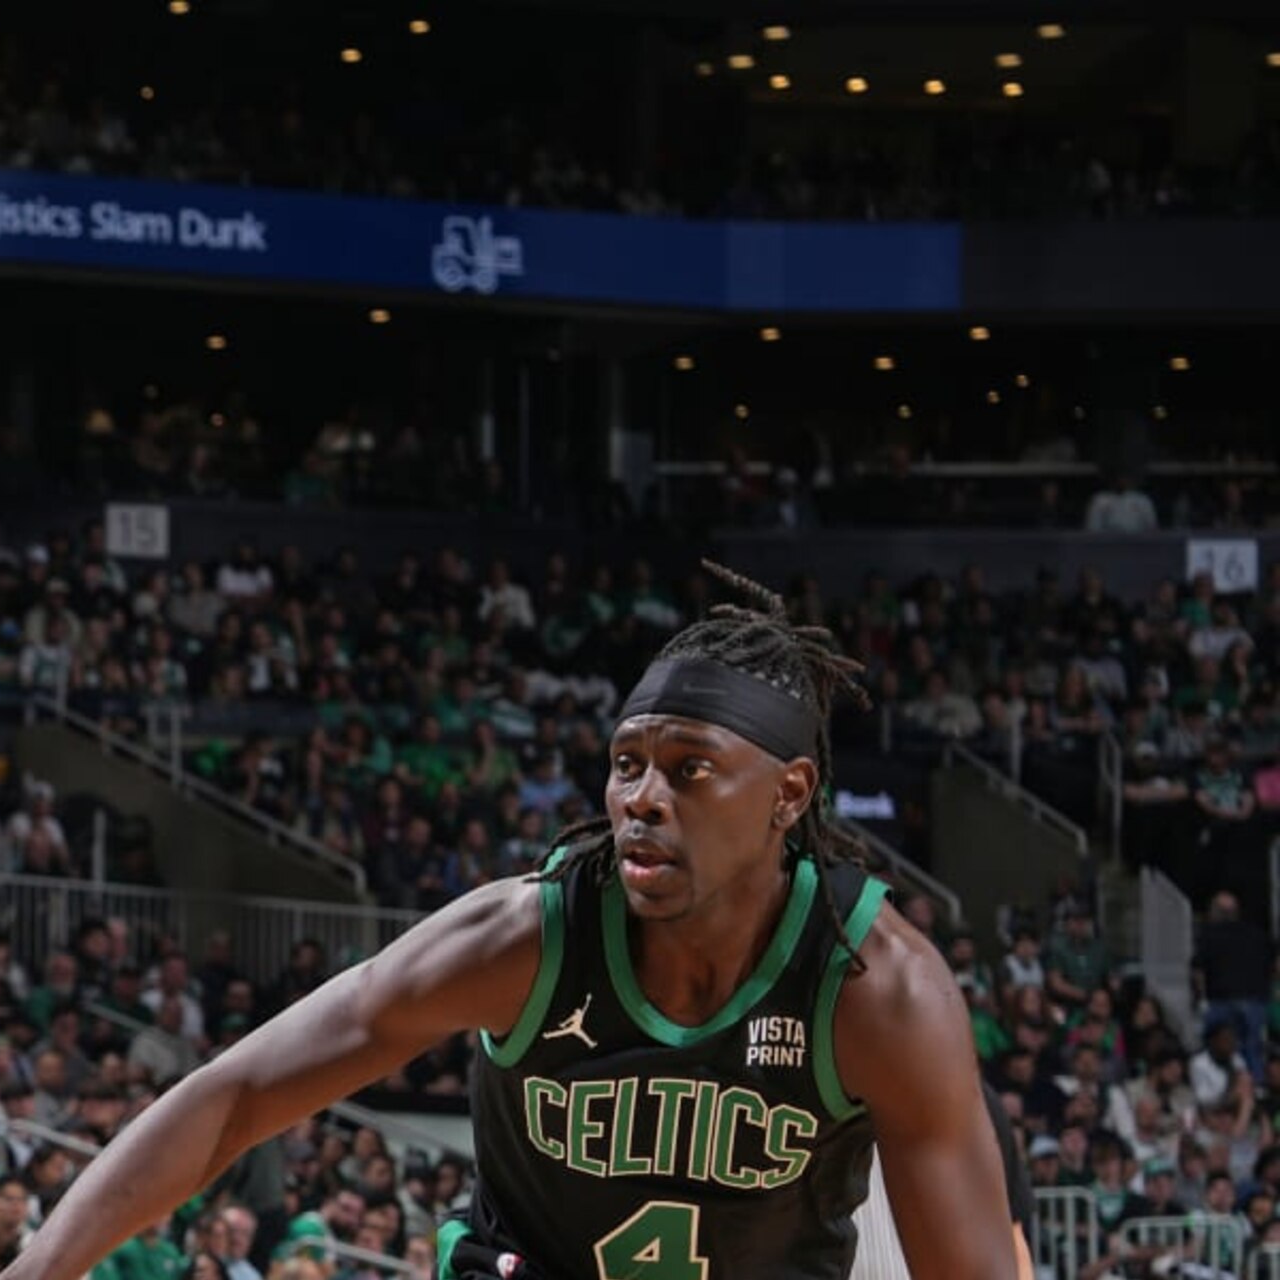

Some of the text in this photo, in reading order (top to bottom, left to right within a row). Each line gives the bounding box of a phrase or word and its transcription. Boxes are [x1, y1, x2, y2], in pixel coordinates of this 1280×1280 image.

[91, 201, 172, 243] Slam
[179, 208, 267, 250] Dunk
[118, 509, 158, 551] 15
[747, 1015, 806, 1048] VISTA
[746, 1046, 806, 1068] PRINT
[524, 1076, 818, 1189] CELTICS
